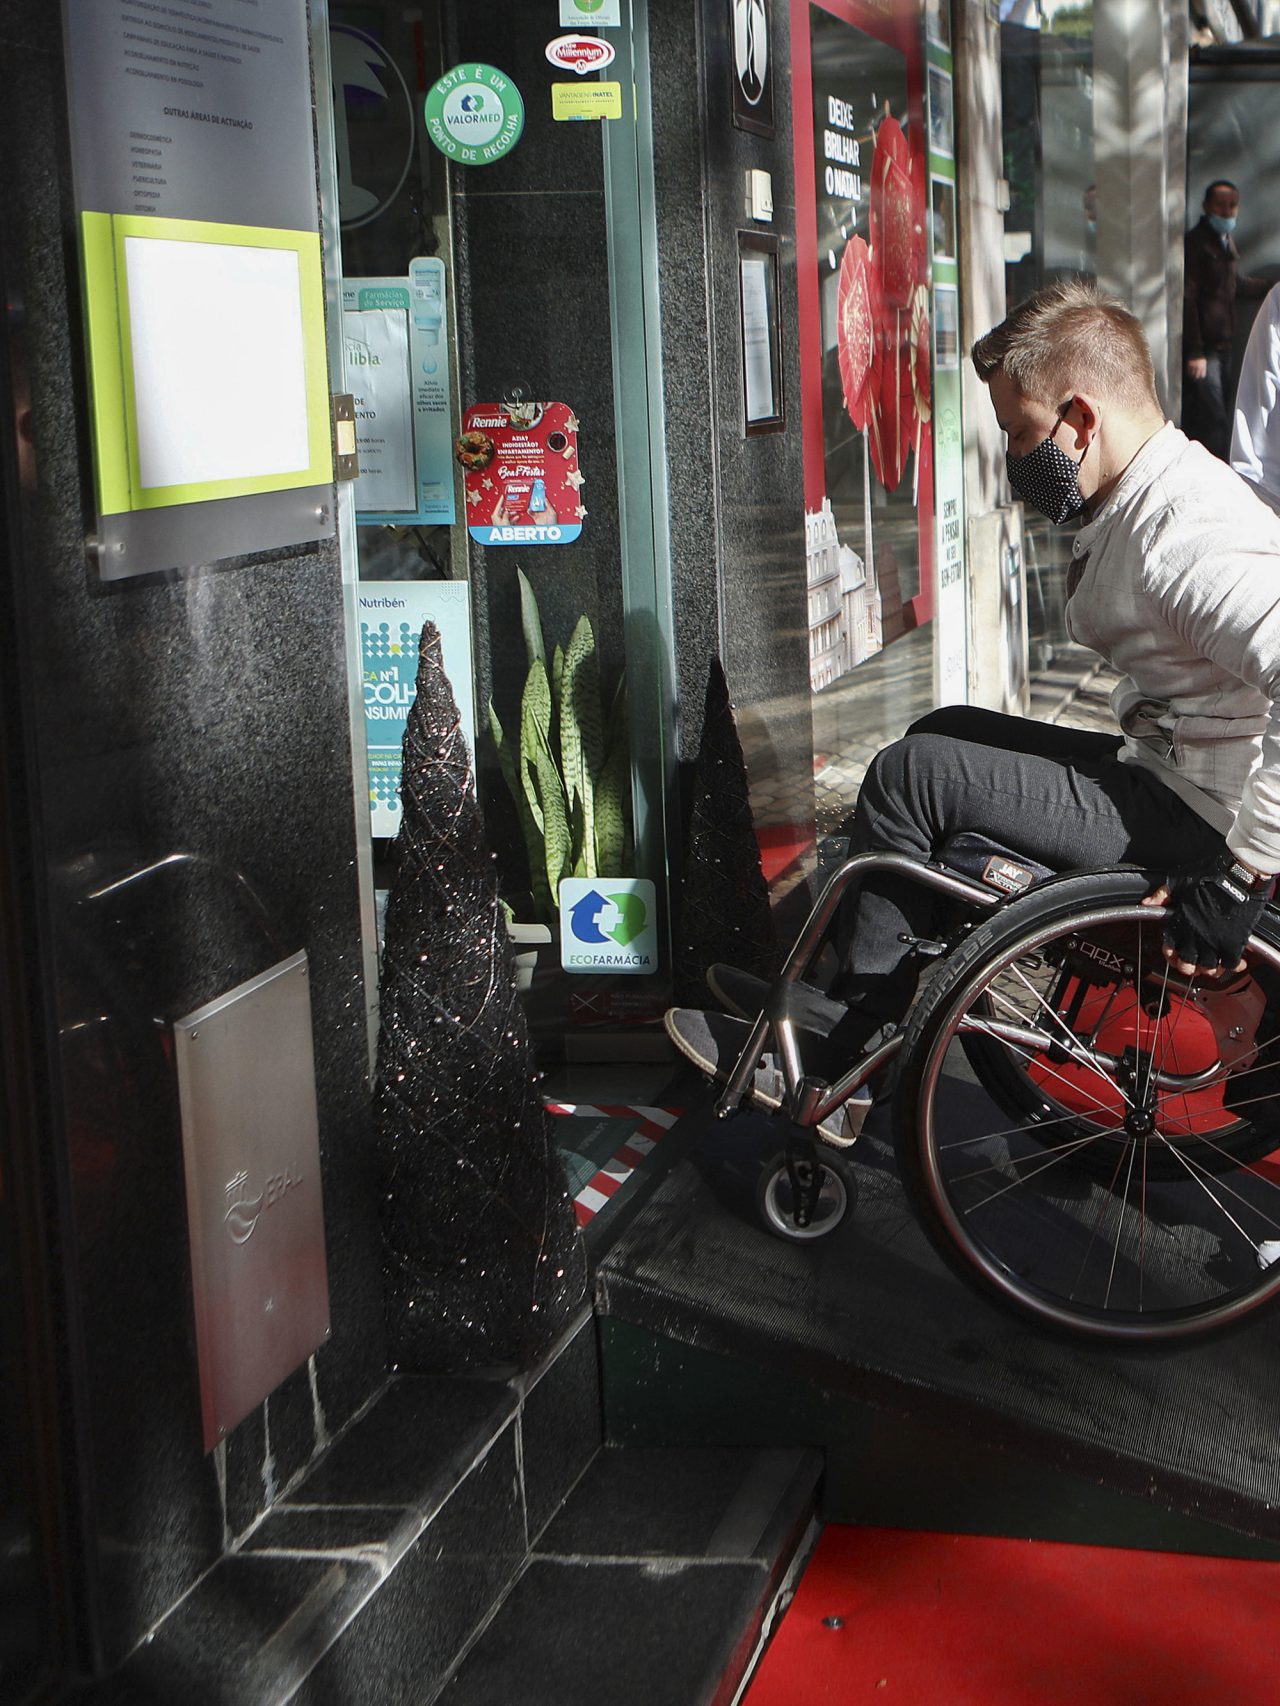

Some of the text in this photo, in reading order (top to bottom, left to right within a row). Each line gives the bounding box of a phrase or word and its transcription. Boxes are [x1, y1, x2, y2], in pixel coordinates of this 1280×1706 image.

[557, 48, 602, 57] Millennium
[436, 66, 506, 94] ESTE É UM
[163, 106, 253, 130] OUTRAS ÁREAS DE ACTUAÇÃO
[446, 113, 500, 125] VALORMED
[828, 95, 854, 131] DEIXE
[430, 113, 518, 160] PONTO DE RECOLHA
[824, 129, 860, 167] BRILHAR
[825, 165, 835, 195] O
[365, 290, 402, 298] Farmácias
[375, 299, 405, 308] Serviço
[472, 416, 508, 428] Rennie
[502, 440, 539, 448] INDIGESTÃO?
[508, 484, 530, 493] Rennie
[489, 526, 562, 541] ABERTO
[358, 597, 405, 609] Nutribén
[569, 952, 651, 965] ECOFARMÁCIA
